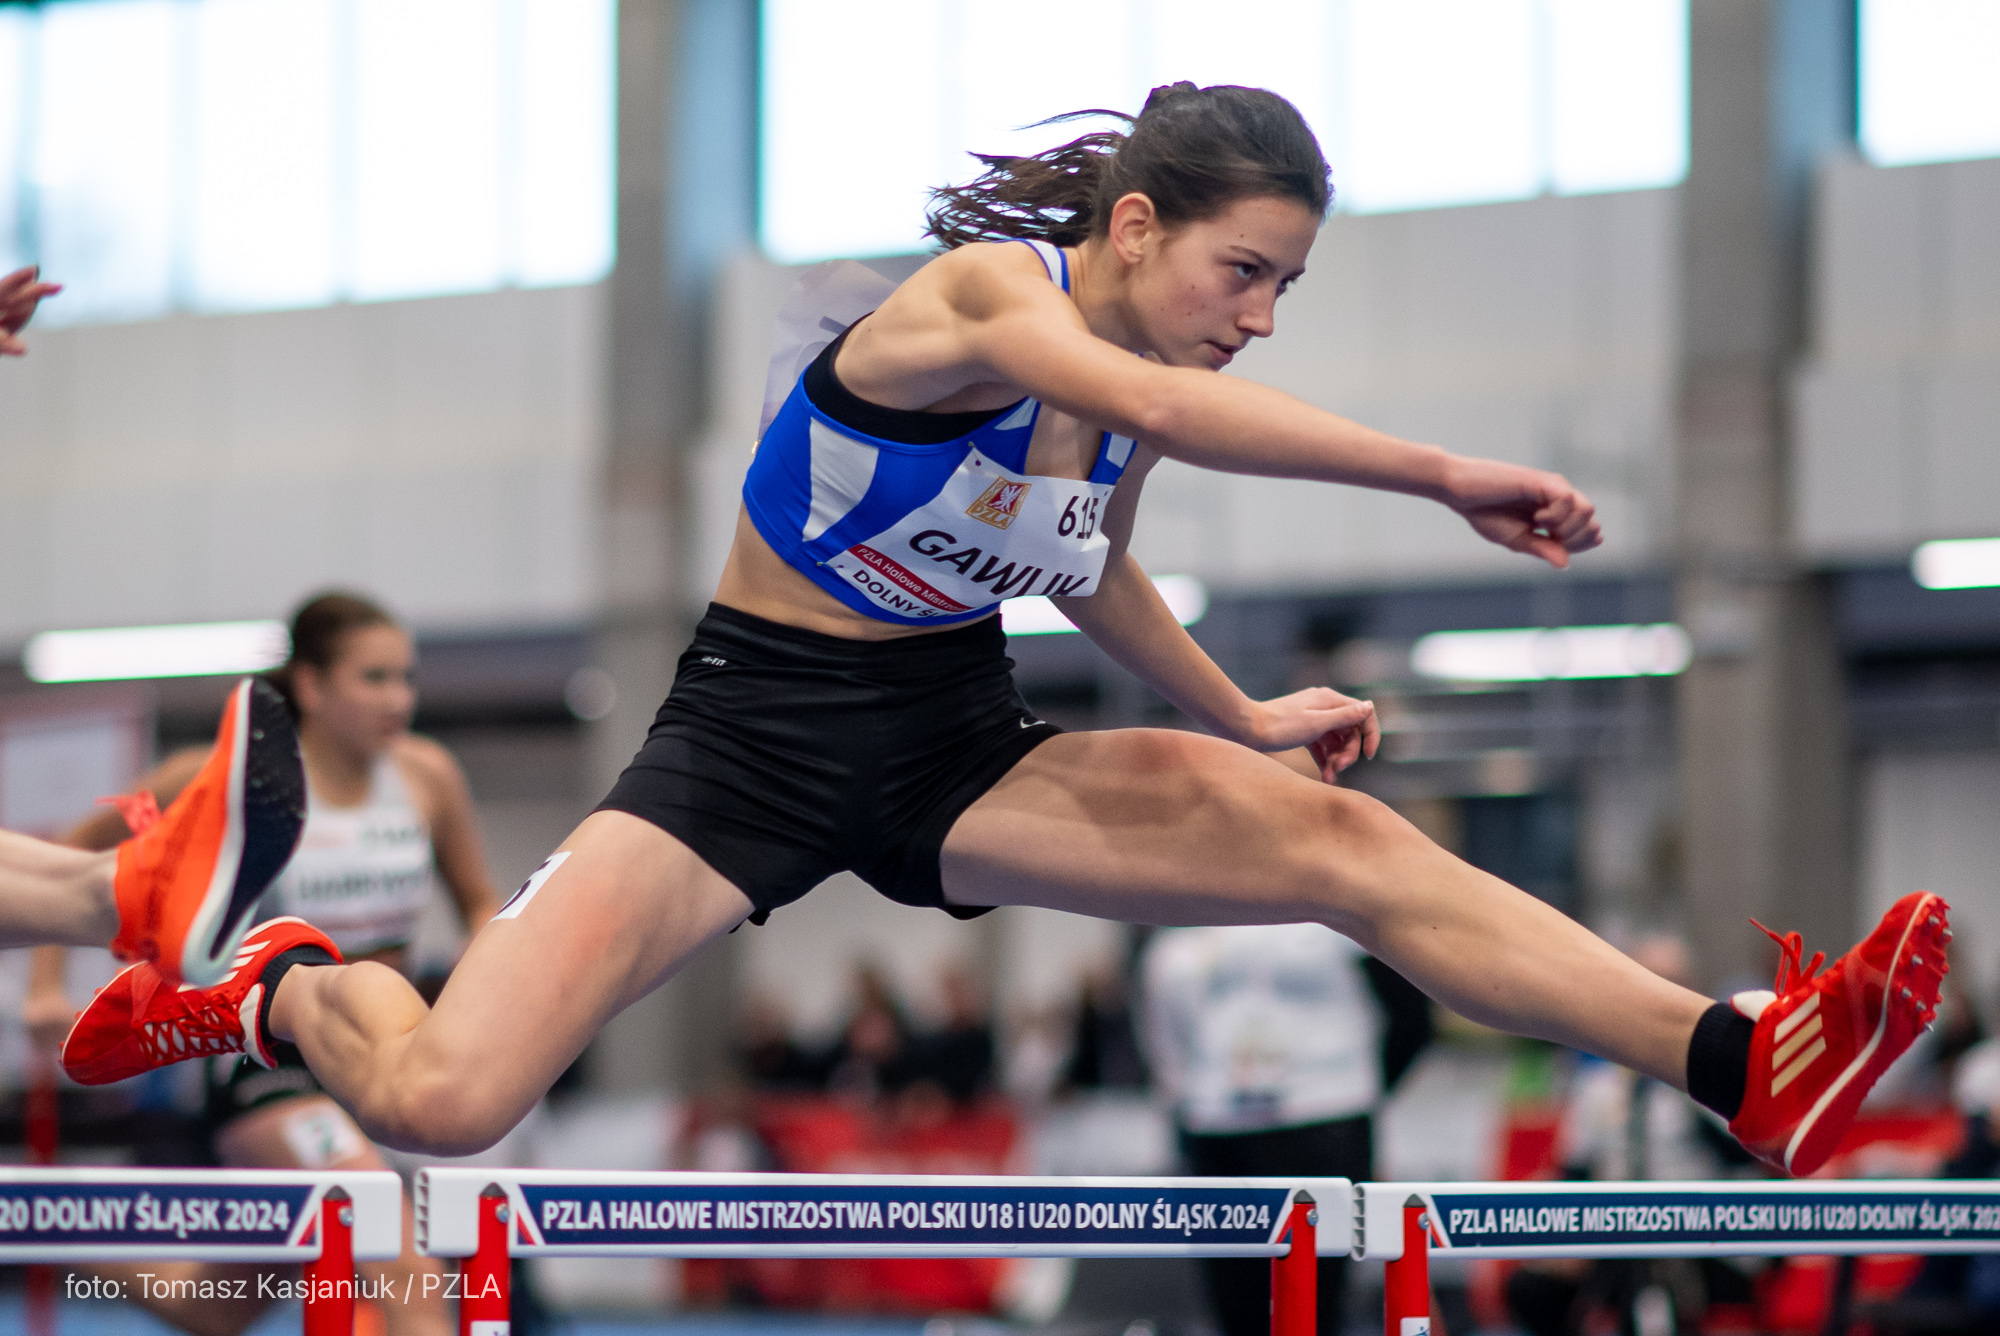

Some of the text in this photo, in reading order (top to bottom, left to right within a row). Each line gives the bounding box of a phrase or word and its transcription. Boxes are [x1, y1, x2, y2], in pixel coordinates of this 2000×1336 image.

[968, 503, 1011, 527] PZLA
[1057, 495, 1100, 540] 615
[852, 569, 921, 613] DOLNY
[857, 547, 884, 567] PZLA
[882, 562, 922, 593] Halowe
[33, 1198, 131, 1231] DOLNY
[134, 1192, 221, 1239] ŚLĄSK
[224, 1201, 290, 1231] 2024
[543, 1198, 1271, 1236] PZLA HALOWE MISTRZOSTWA POLSKI U18 i U20 DOLNY ŚLĄSK 2024
[1449, 1208, 1498, 1234] PZLA
[1500, 1206, 1580, 1233] HALOWE
[1582, 1205, 1712, 1232] MISTRZOSTWA
[1714, 1205, 1776, 1231] POLSKI
[1778, 1204, 1812, 1231] U18
[1814, 1204, 1822, 1231] i
[1823, 1204, 1858, 1231] U20
[1859, 1204, 1918, 1231] DOLNY
[1919, 1199, 1972, 1237] ŚLĄSK
